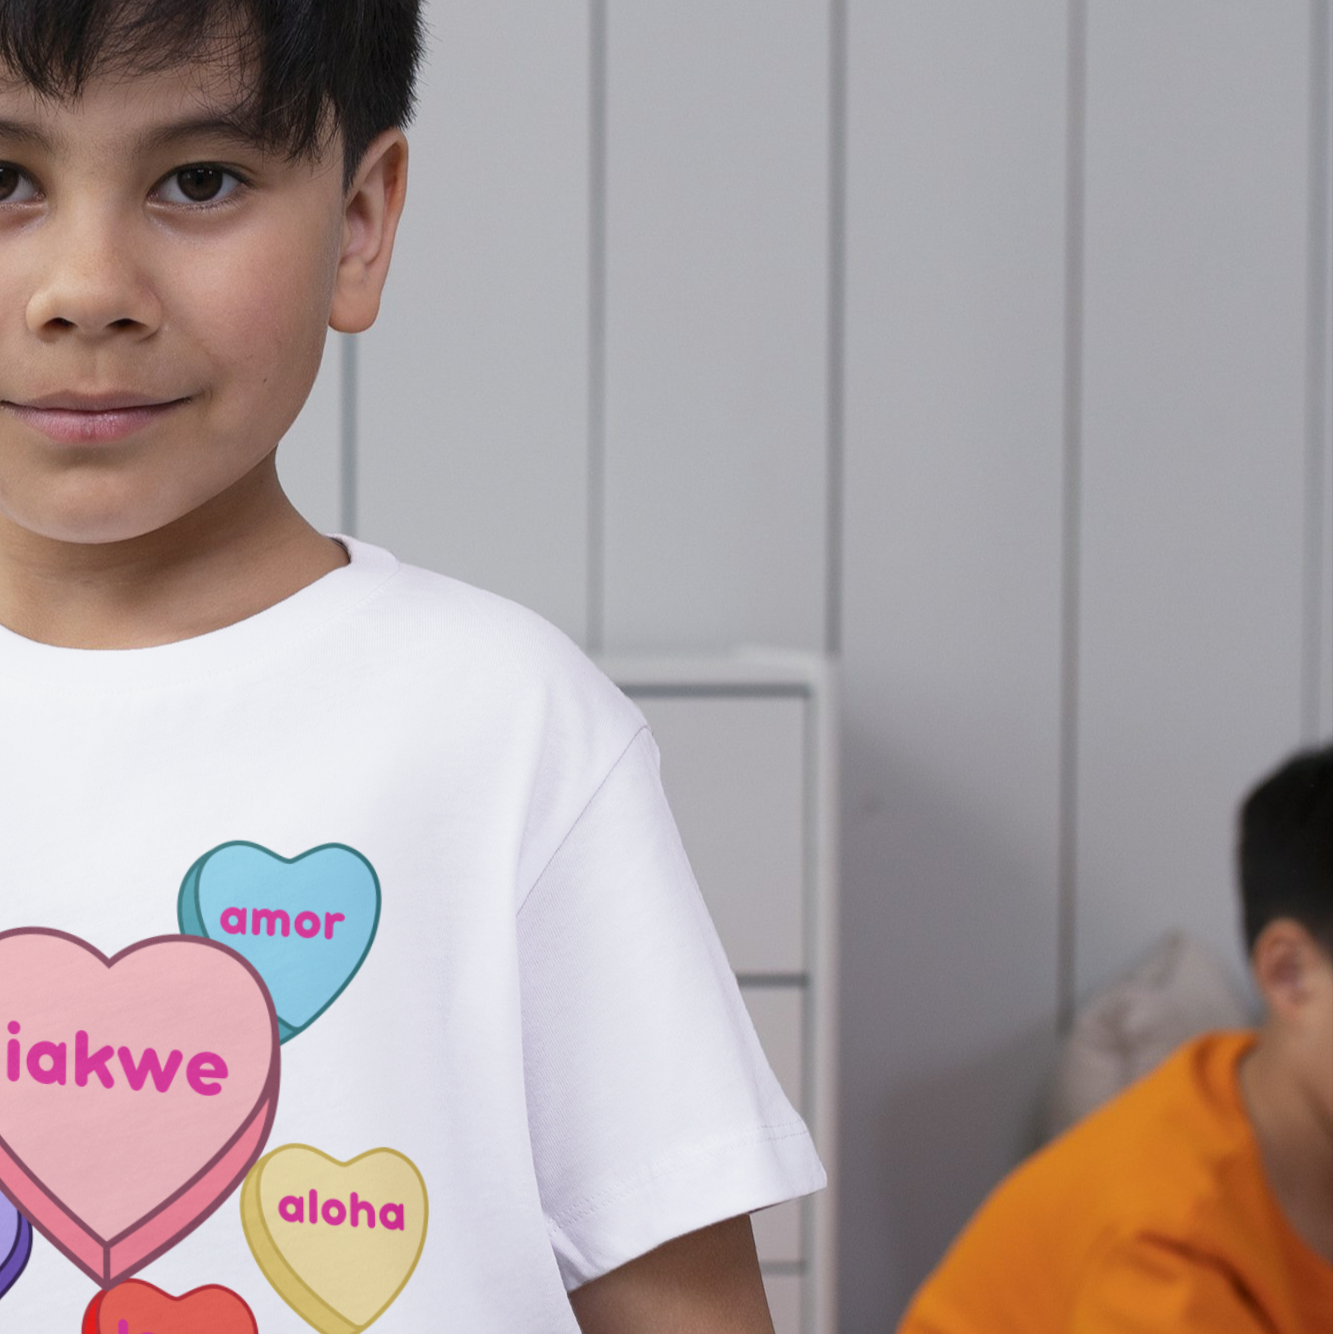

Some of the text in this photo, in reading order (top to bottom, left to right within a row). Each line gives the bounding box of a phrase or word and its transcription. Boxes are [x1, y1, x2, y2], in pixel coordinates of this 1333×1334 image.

[219, 906, 346, 940] amor
[6, 1020, 230, 1097] iakwe
[277, 1188, 406, 1231] aloha
